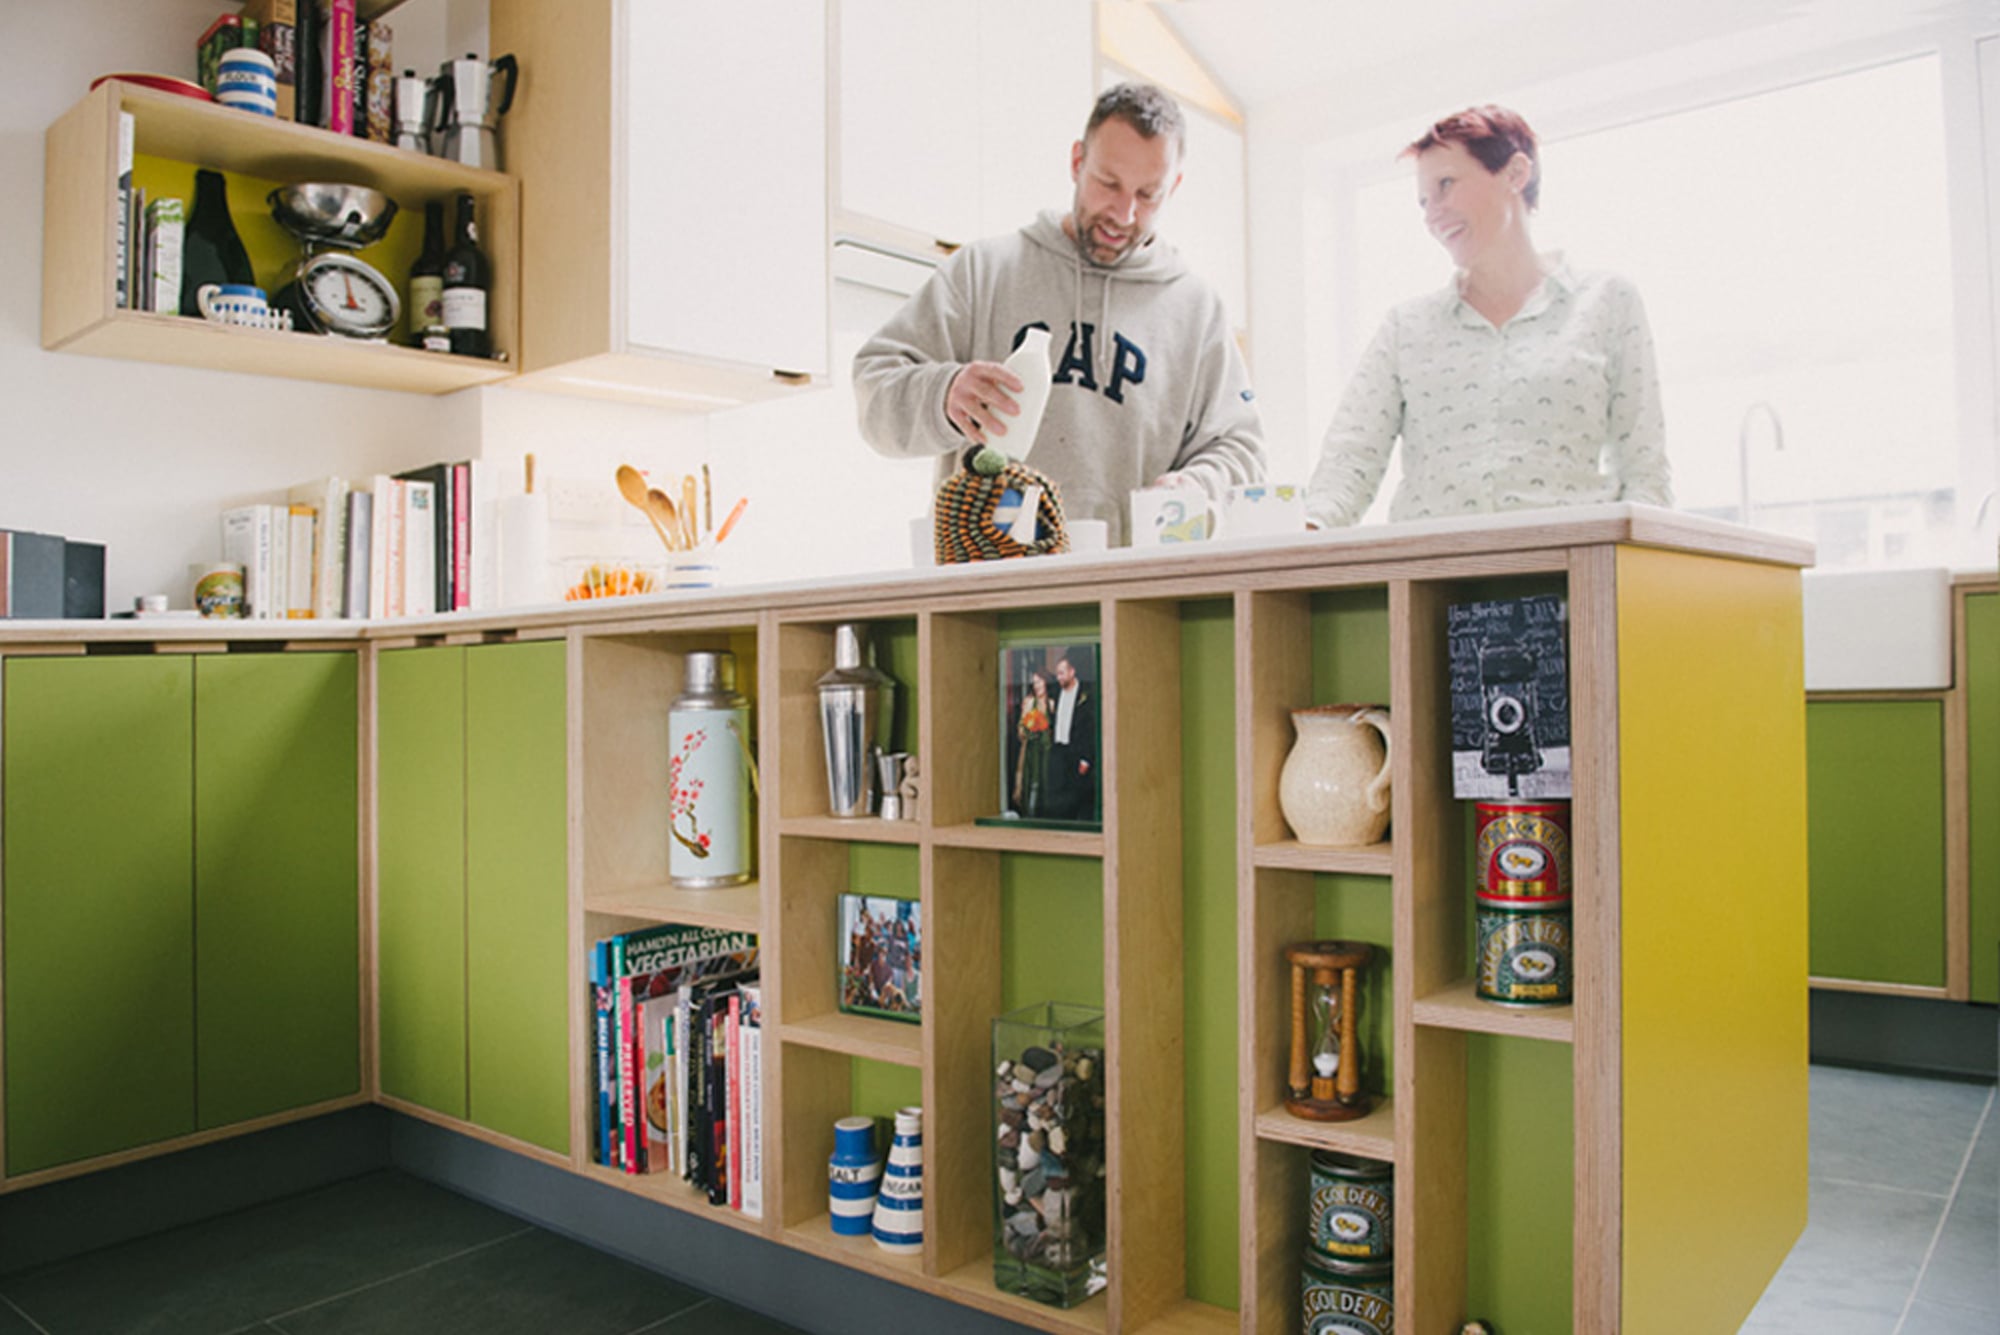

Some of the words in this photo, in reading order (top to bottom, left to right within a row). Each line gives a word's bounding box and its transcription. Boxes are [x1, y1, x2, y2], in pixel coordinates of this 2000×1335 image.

[626, 933, 678, 957] HAMLYN
[681, 929, 700, 943] ALL
[1502, 923, 1562, 945] GOLDEN
[626, 931, 749, 975] VEGETARIAN
[623, 1042, 634, 1127] PRESERVED
[1322, 1187, 1379, 1208] GOLDEN
[1309, 1290, 1381, 1320] GOLDEN
